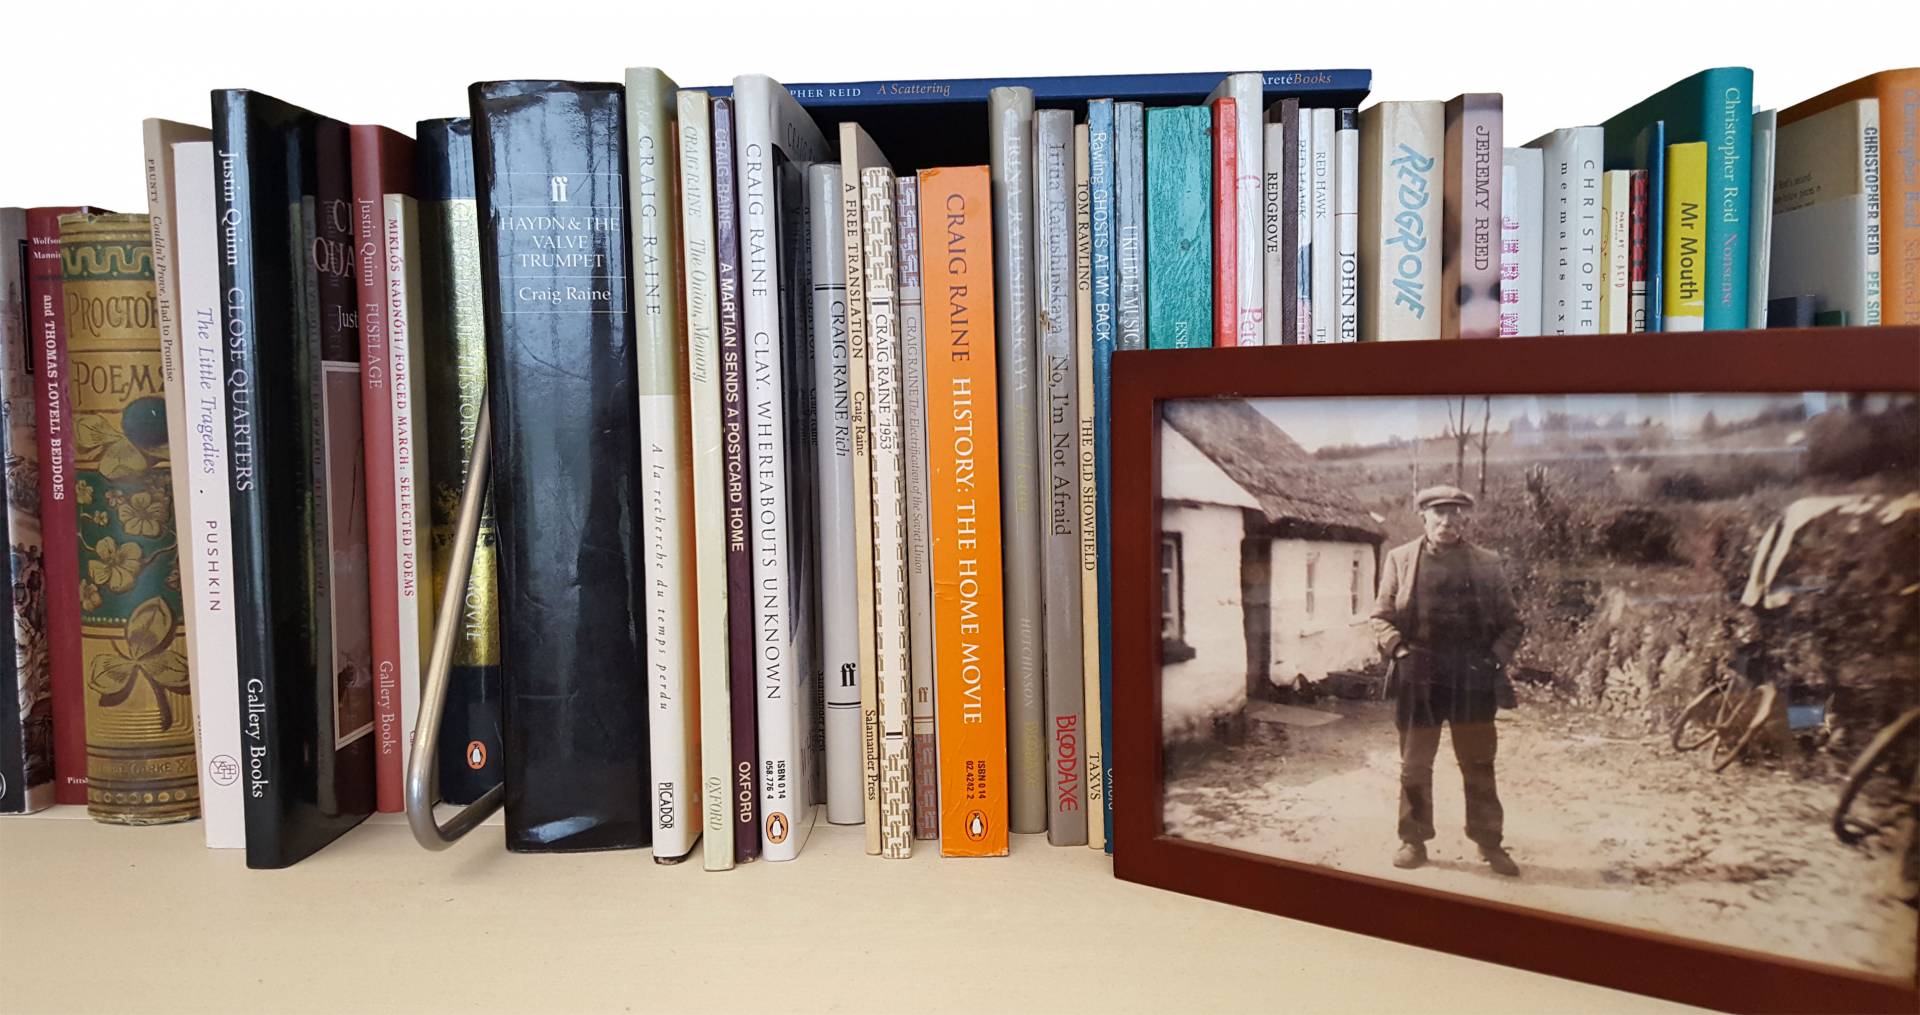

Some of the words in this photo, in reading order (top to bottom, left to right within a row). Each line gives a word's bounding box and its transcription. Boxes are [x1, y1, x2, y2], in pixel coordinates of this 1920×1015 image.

[829, 88, 862, 98] REID
[876, 84, 887, 96] A
[891, 83, 951, 97] Scattering
[683, 126, 698, 170] CRAIG
[714, 128, 731, 177] CRAIG
[1090, 132, 1107, 186] Rawling
[1718, 87, 1741, 182] Christopher
[219, 150, 240, 202] Justin
[639, 136, 657, 218] CRAIG
[746, 144, 764, 215] CRAIG
[845, 184, 856, 192] A
[1049, 143, 1066, 192] Irina
[1316, 152, 1326, 177] RED
[1475, 125, 1490, 211] JEREMY
[1863, 127, 1879, 219] CHRISTOPHER
[359, 200, 376, 238] Justin
[685, 173, 699, 217] RAINE
[717, 181, 733, 230] RAINE
[846, 200, 858, 237] FREE
[1078, 180, 1089, 215] TOM
[1093, 189, 1108, 250] GHOSTS
[1266, 172, 1278, 253] REDGROVE
[1316, 181, 1326, 219] HAWK
[1681, 202, 1698, 230] Mr
[1723, 186, 1739, 223] Reid
[222, 208, 242, 266] Quinn
[388, 219, 400, 273] MIKLÓS
[501, 216, 566, 231] HAYDN
[567, 216, 582, 231] &
[584, 216, 620, 231] THE
[532, 236, 589, 249] VALVE
[946, 194, 968, 276] CRAIG
[1384, 142, 1435, 320] REDGROVE
[1474, 217, 1490, 271] REED
[1559, 162, 1568, 281] mermaids
[1866, 225, 1880, 256] REID
[360, 242, 377, 286] Quinn
[519, 254, 604, 268] TRUMPET
[643, 237, 661, 316] RAINE
[689, 239, 705, 265] The
[721, 263, 732, 273] A
[750, 229, 767, 297] RAINE
[1050, 202, 1069, 334] Ratushinskaya
[1079, 222, 1090, 291] RAWLING
[1095, 253, 1108, 271] AT
[1679, 237, 1698, 299] Mouth
[1720, 233, 1737, 304] Nonsense
[519, 287, 562, 304] Craig
[567, 287, 612, 301] Raine
[690, 269, 708, 317] Onion,
[848, 242, 864, 359] TRANSLATION
[1095, 275, 1109, 300] MY
[1339, 251, 1356, 307] JOHN
[1867, 272, 1880, 298] PEA
[43, 295, 53, 316] and
[160, 300, 170, 320] Had
[162, 324, 171, 336] to
[197, 308, 213, 342] The
[227, 287, 247, 362] CLOSE
[391, 280, 405, 342] RADNÓTI
[721, 279, 736, 346] MARTIAN
[830, 301, 847, 359] CRAIG
[949, 284, 970, 362] RAINE
[1095, 303, 1110, 342] BACK
[1124, 297, 1140, 344] MUSIC
[44, 320, 59, 378] THOMAS
[164, 338, 173, 382] Promise
[366, 304, 383, 389] FUSELAGE
[694, 322, 711, 383] Memory
[876, 315, 889, 366] CRAIG
[907, 316, 919, 355] CRAIG
[198, 346, 216, 389] Little
[395, 355, 408, 409] FORCED
[724, 352, 738, 403] SENDS
[754, 331, 771, 391] CLAY.
[907, 355, 920, 395] RAINE
[1052, 355, 1068, 388] No,
[48, 381, 61, 435] LOVELL
[726, 408, 739, 418] A
[833, 364, 849, 421] RAINE
[851, 391, 865, 423] Craig
[877, 369, 891, 413] RAINE
[909, 398, 920, 416] The
[1053, 393, 1069, 424] I'm
[197, 395, 217, 475] Tragedies
[228, 363, 254, 492] QUARTERS
[397, 416, 409, 470] MARCH:
[651, 444, 664, 453] A
[835, 425, 849, 457] Rich
[855, 425, 867, 456] Raine
[910, 417, 923, 484] Electrification
[952, 377, 975, 493] HISTORY:
[1054, 432, 1070, 468] Not
[1082, 417, 1093, 447] THE
[50, 439, 64, 500] BEDDOES
[653, 465, 664, 479] la
[727, 422, 742, 502] POSTCARD
[757, 401, 777, 567] WHEREABOUTS
[1082, 451, 1094, 482] OLD
[400, 477, 413, 547] SELECTED
[654, 489, 668, 569] recherche
[730, 507, 744, 552] HOME
[912, 513, 924, 542] Soviet
[957, 499, 976, 550] THE
[1054, 476, 1072, 536] Afraid
[1083, 485, 1096, 571] SHOWFIELD
[206, 520, 221, 612] PUSHKIN
[403, 553, 414, 597] POEMS
[914, 544, 924, 574] Union
[656, 579, 668, 598] du
[959, 560, 979, 636] HOME
[655, 608, 668, 654] temps
[762, 577, 781, 699] UNKNOWN
[379, 661, 395, 710] Gallery
[961, 643, 982, 725] MOVIE
[1021, 618, 1034, 706] HUTCHINSON
[245, 678, 267, 740] Gallery
[657, 664, 671, 710] perdu
[381, 714, 396, 755] Books
[865, 710, 879, 769] Salamander
[250, 745, 267, 798] Books
[777, 760, 786, 781] ISBN
[868, 769, 880, 801] Press
[977, 760, 986, 782] ISBN
[1056, 714, 1079, 812] BLOODAXE
[1089, 752, 1101, 801] TAXVS
[658, 782, 674, 830] PICADOR
[706, 777, 723, 831] OXFORD
[738, 761, 752, 823] OXFORD
